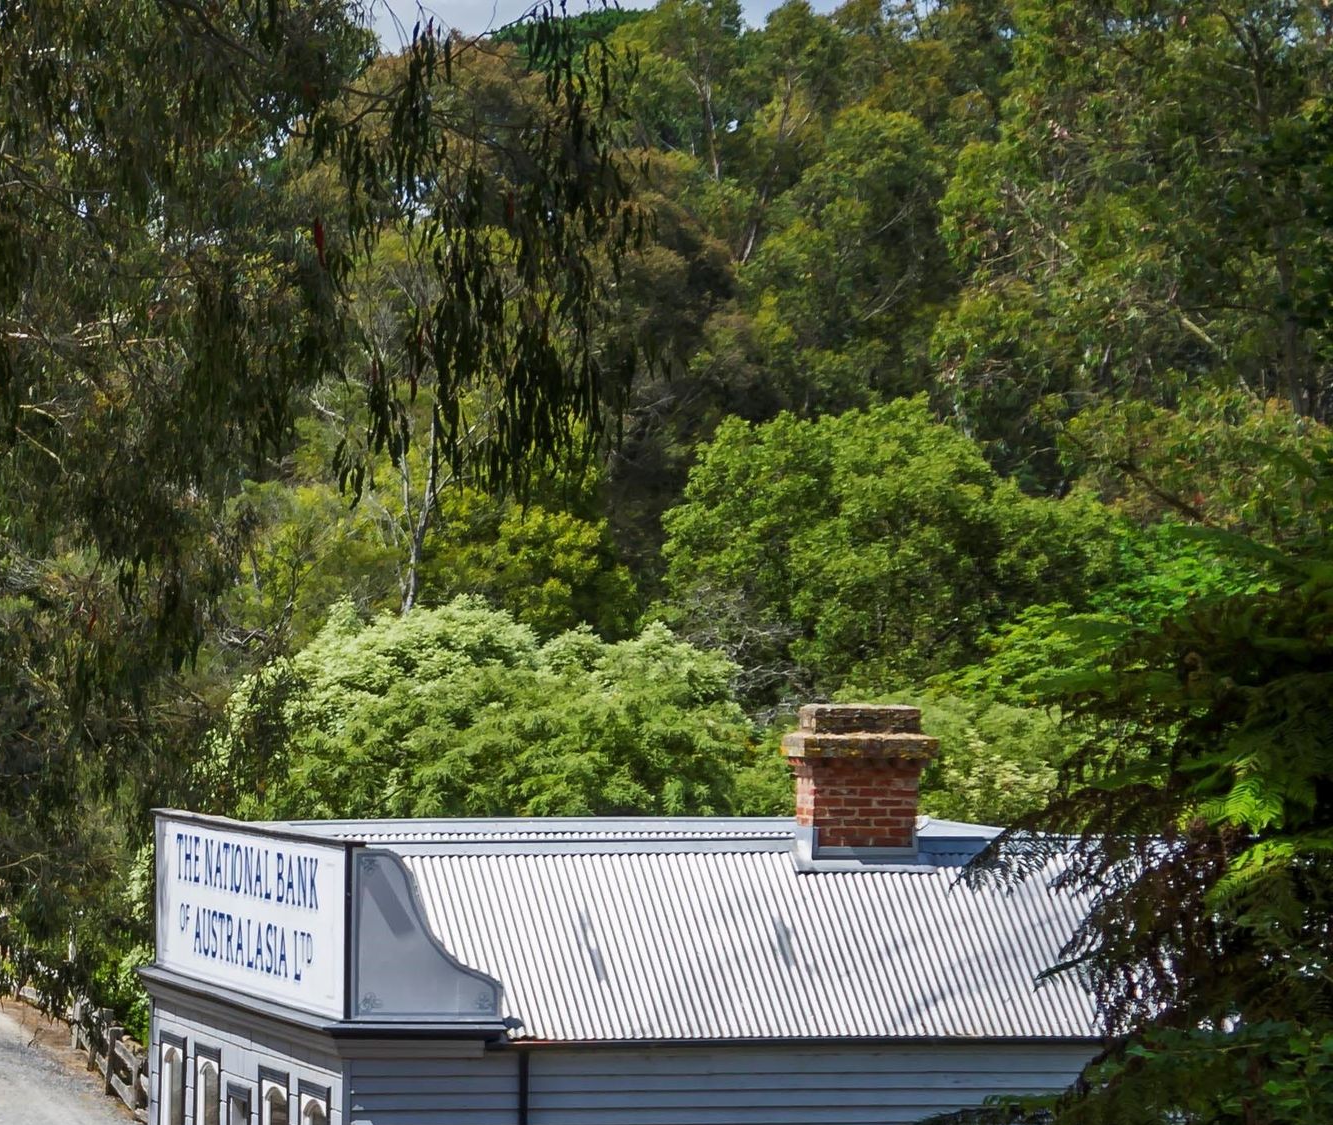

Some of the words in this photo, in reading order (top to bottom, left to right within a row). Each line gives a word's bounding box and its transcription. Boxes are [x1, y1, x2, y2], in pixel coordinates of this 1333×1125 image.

[176, 833, 200, 882] THE
[204, 838, 272, 900] NATIONAL
[276, 852, 319, 910] BANK
[180, 902, 190, 932] OF
[194, 908, 287, 979] AUSTRALASIA
